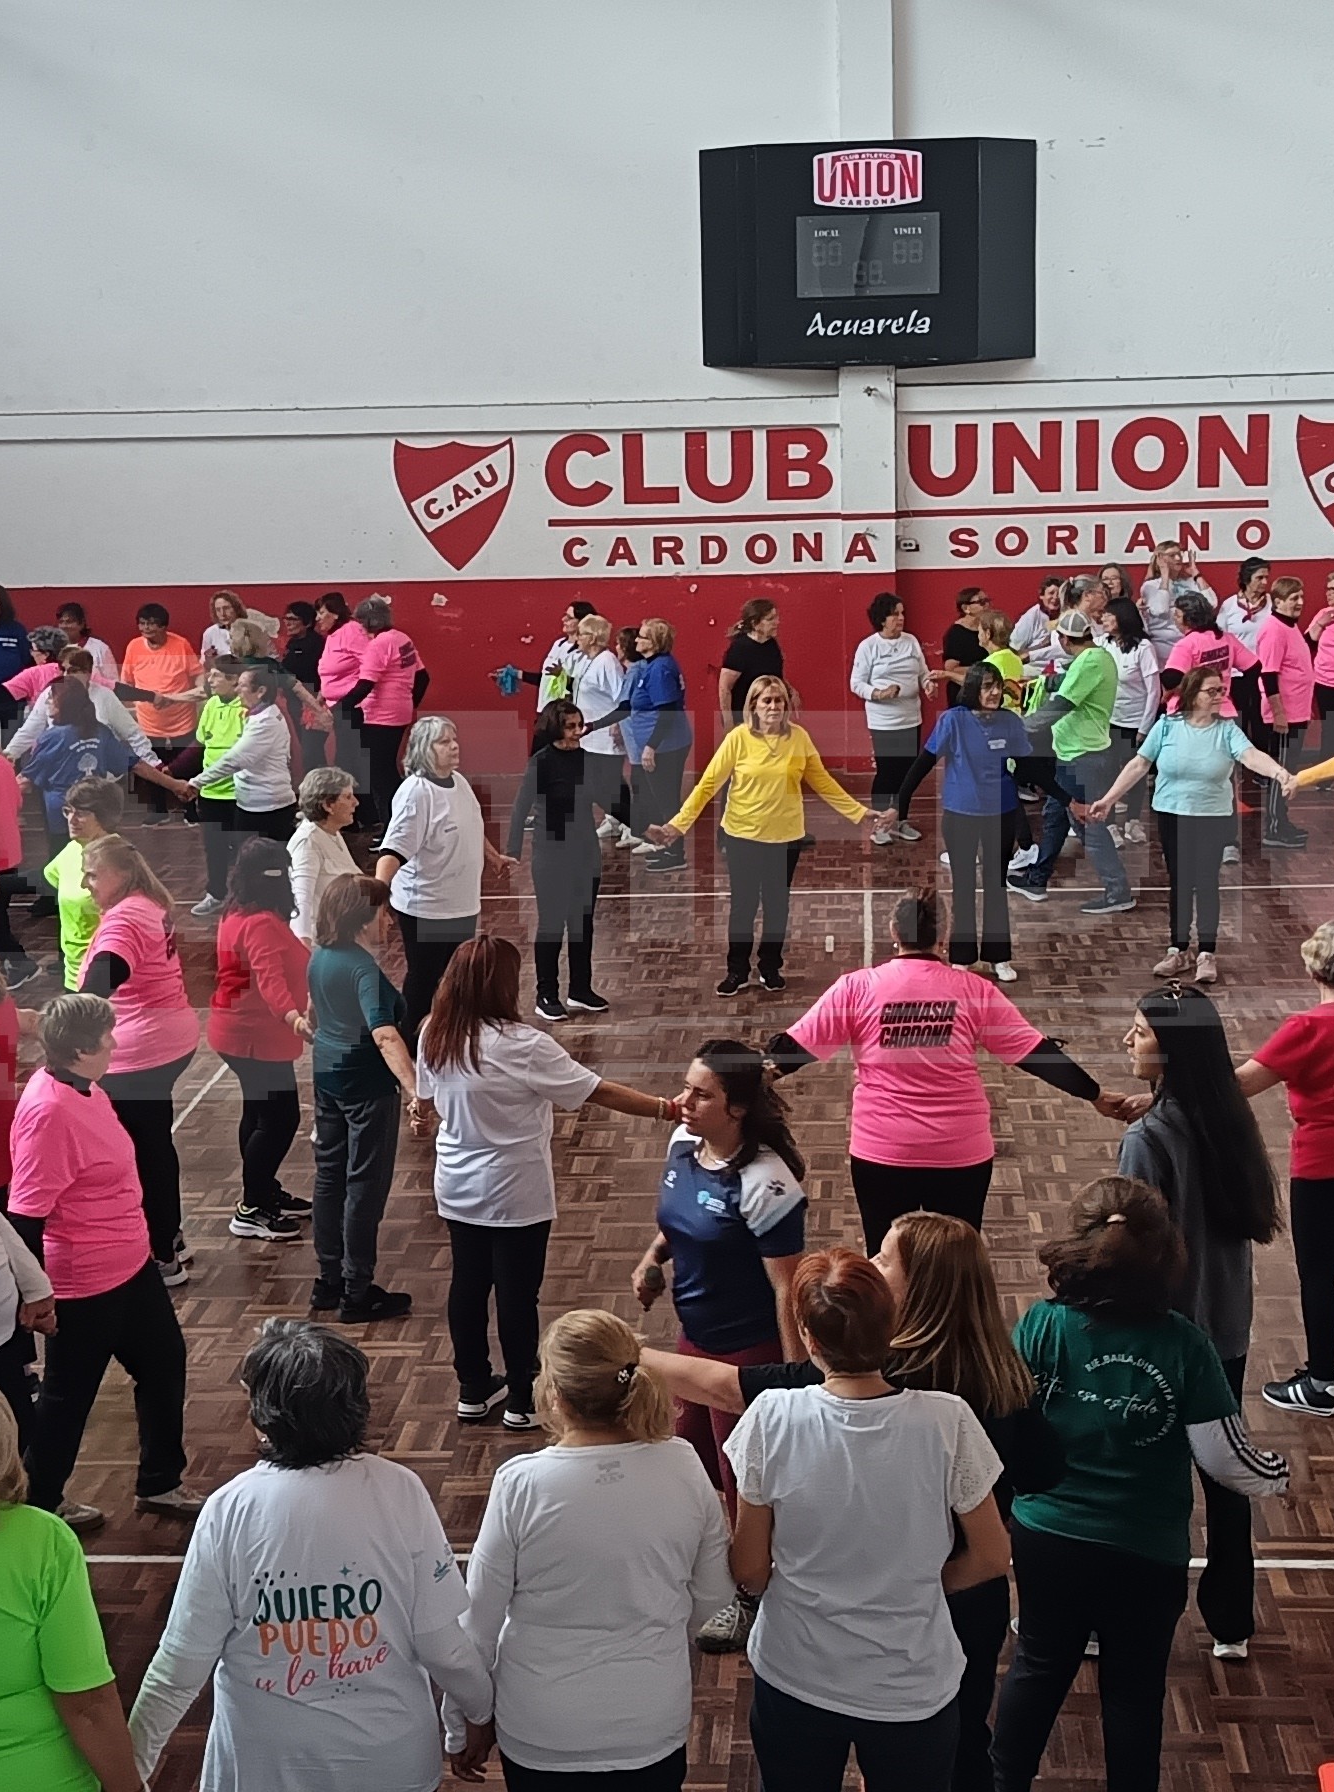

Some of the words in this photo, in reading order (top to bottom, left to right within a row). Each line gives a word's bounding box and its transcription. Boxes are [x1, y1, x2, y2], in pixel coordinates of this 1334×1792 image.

[817, 153, 919, 203] UNION
[839, 198, 896, 206] CARDONA
[814, 229, 840, 238] LOCAL
[893, 226, 922, 235] VISITA
[806, 309, 931, 337] Acuarela
[545, 426, 835, 508] CLUB
[907, 413, 1270, 498] UNION
[423, 463, 499, 521] C.A.U
[562, 531, 877, 568] CARDONA
[949, 519, 1270, 559] SORIANO
[880, 1001, 957, 1025] GIMNASIA
[880, 1024, 953, 1049] CARDONA
[253, 1578, 383, 1627] QUIERO
[259, 1613, 379, 1657] PUEDO
[287, 1654, 317, 1697] lo
[328, 1641, 391, 1681] haré
